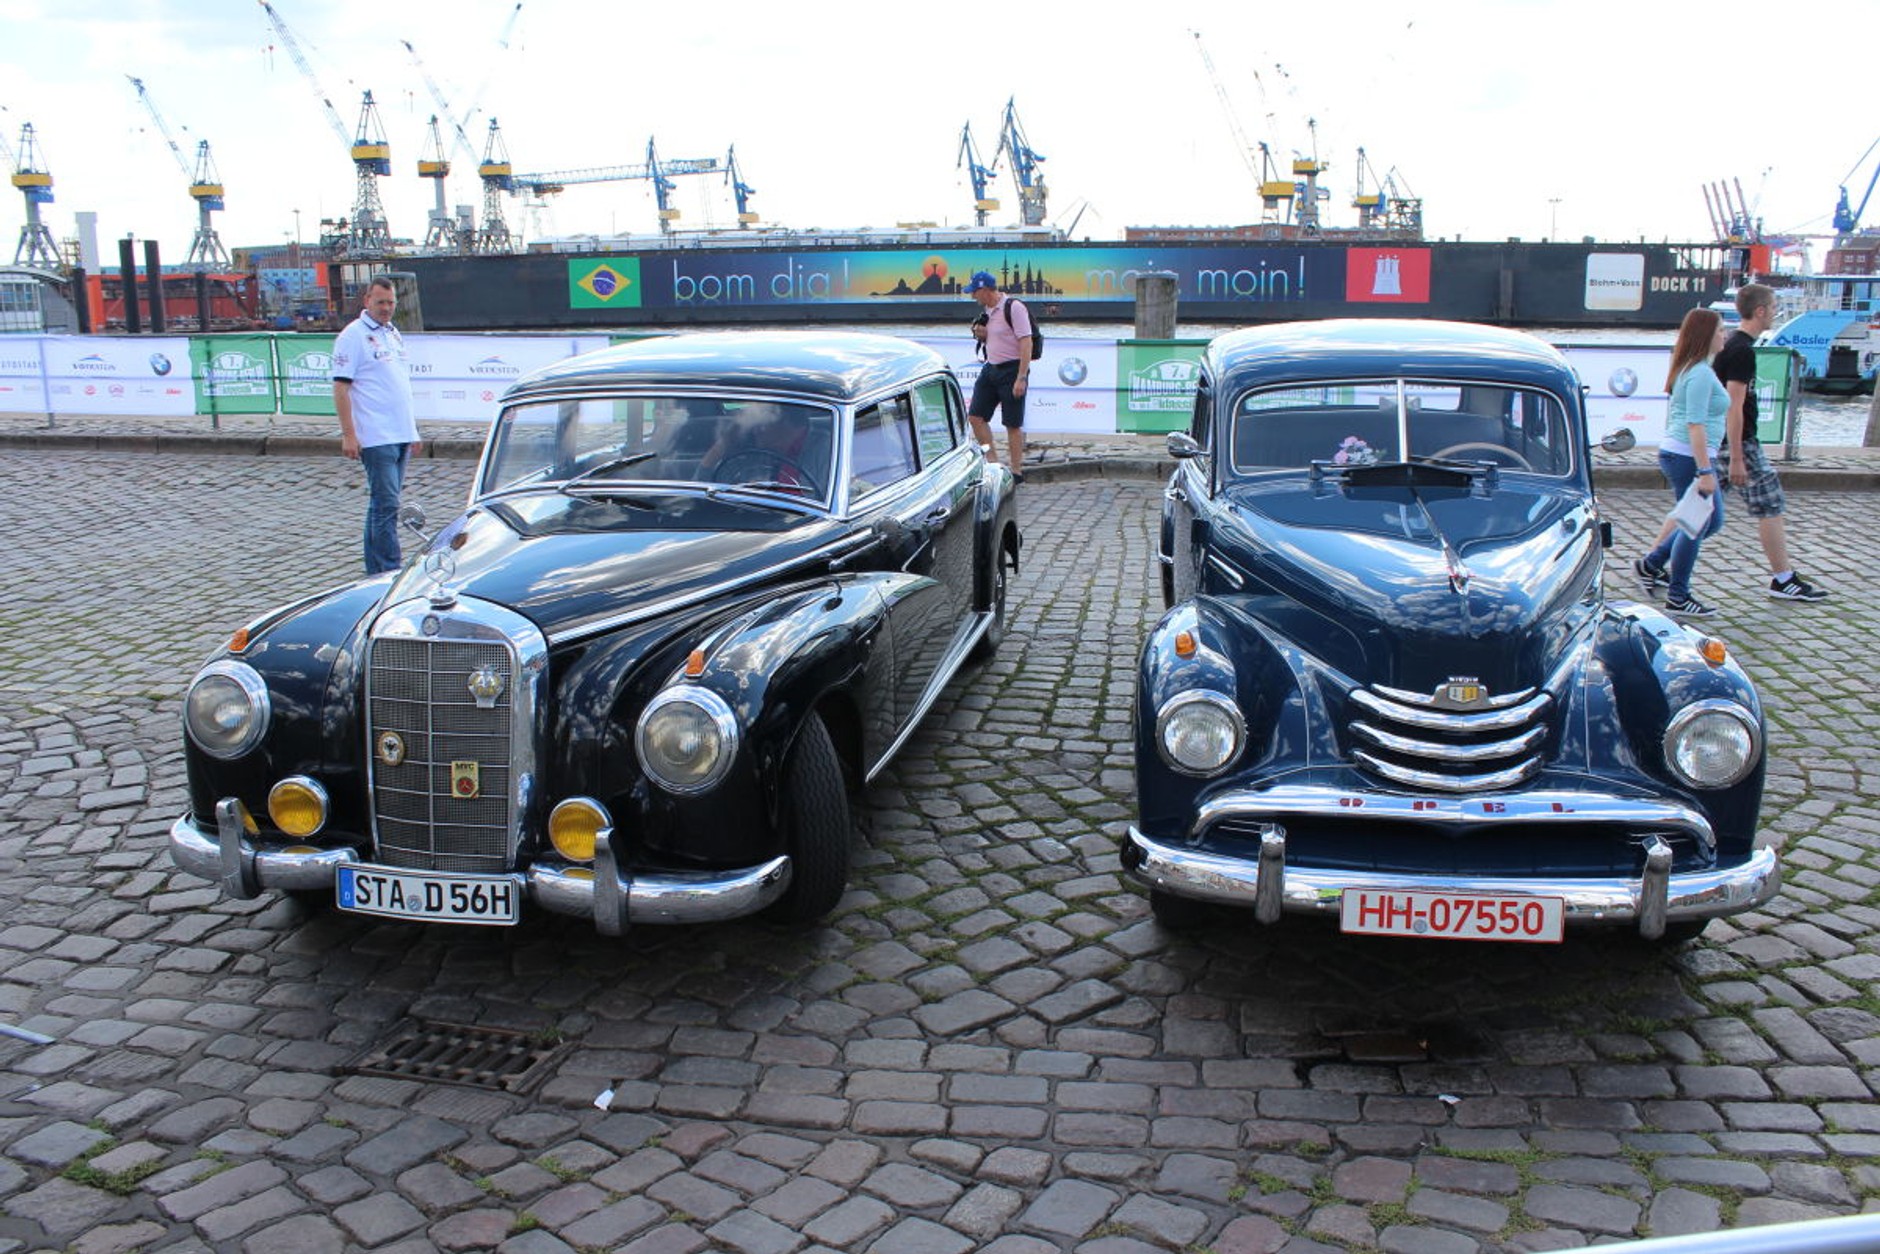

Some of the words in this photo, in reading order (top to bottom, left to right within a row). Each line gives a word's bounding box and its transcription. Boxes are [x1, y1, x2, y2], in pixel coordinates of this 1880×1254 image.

[673, 259, 754, 300] bom
[1085, 260, 1181, 294] mo
[1651, 276, 1688, 292] DOCK
[1692, 277, 1706, 292] 11
[1792, 335, 1830, 345] Basler
[355, 874, 405, 910] STA
[424, 882, 443, 912] D
[450, 883, 511, 915] 56H
[1358, 894, 1545, 936] HH-07550
